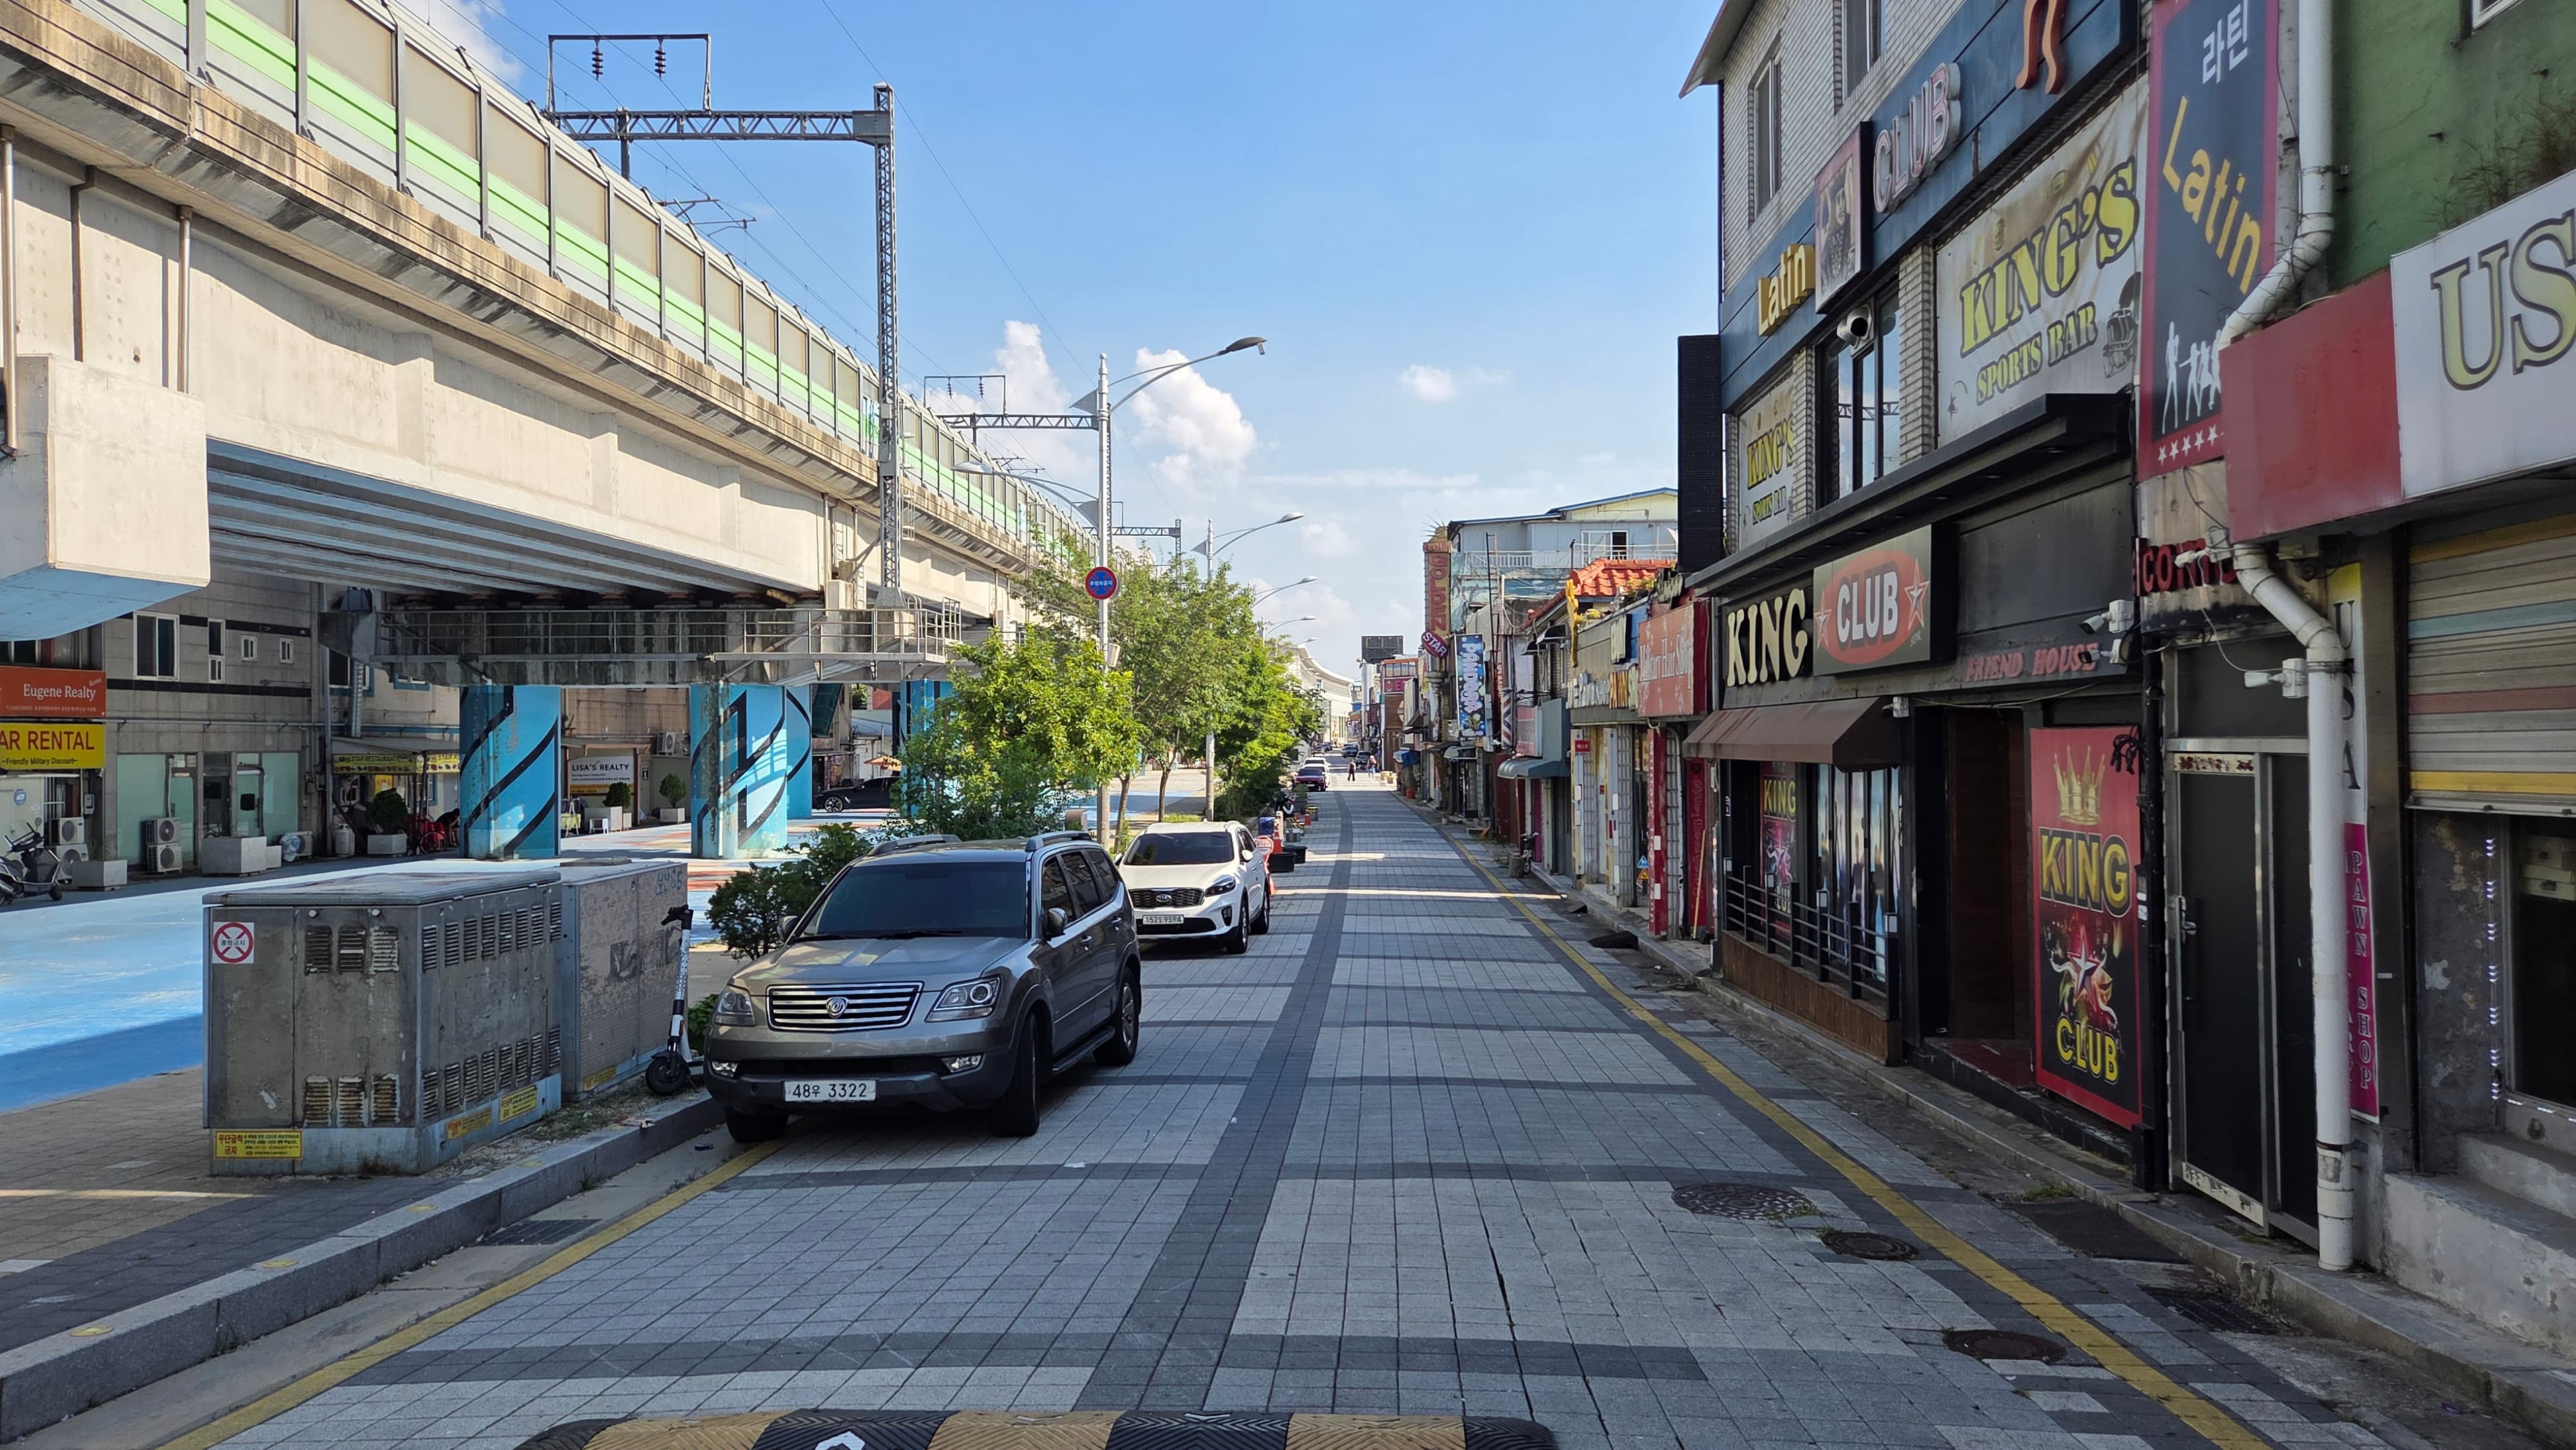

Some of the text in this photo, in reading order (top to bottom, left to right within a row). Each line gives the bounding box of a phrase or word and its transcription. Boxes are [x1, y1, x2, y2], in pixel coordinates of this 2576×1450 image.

[2202, 0, 2248, 85] 라틴
[1874, 62, 1962, 214] CLUB
[2162, 95, 2261, 294] Latin
[1758, 243, 1814, 336] Latin
[1960, 156, 2139, 356] KING'S
[2430, 208, 2576, 391] US
[1976, 302, 2098, 406] SPORTS BAR
[1428, 554, 1448, 632] GOLDEN
[1837, 571, 1898, 643] CLUB
[1423, 632, 1448, 657] STAR
[1727, 588, 1808, 687] KING
[1965, 651, 2023, 682] FRIEND
[23, 683, 96, 702] Eugene Realty
[1460, 643, 1483, 714] PANDORA
[28, 730, 95, 750] RENTAL
[30, 757, 50, 765] Military
[1764, 779, 1796, 814] KING
[2039, 829, 2131, 917] KING
[2351, 850, 2371, 1090] PAWN SHOP
[2055, 1013, 2119, 1085] CLUB
[792, 1083, 867, 1098] 48우 3322
[224, 1146, 237, 1155] 금지
